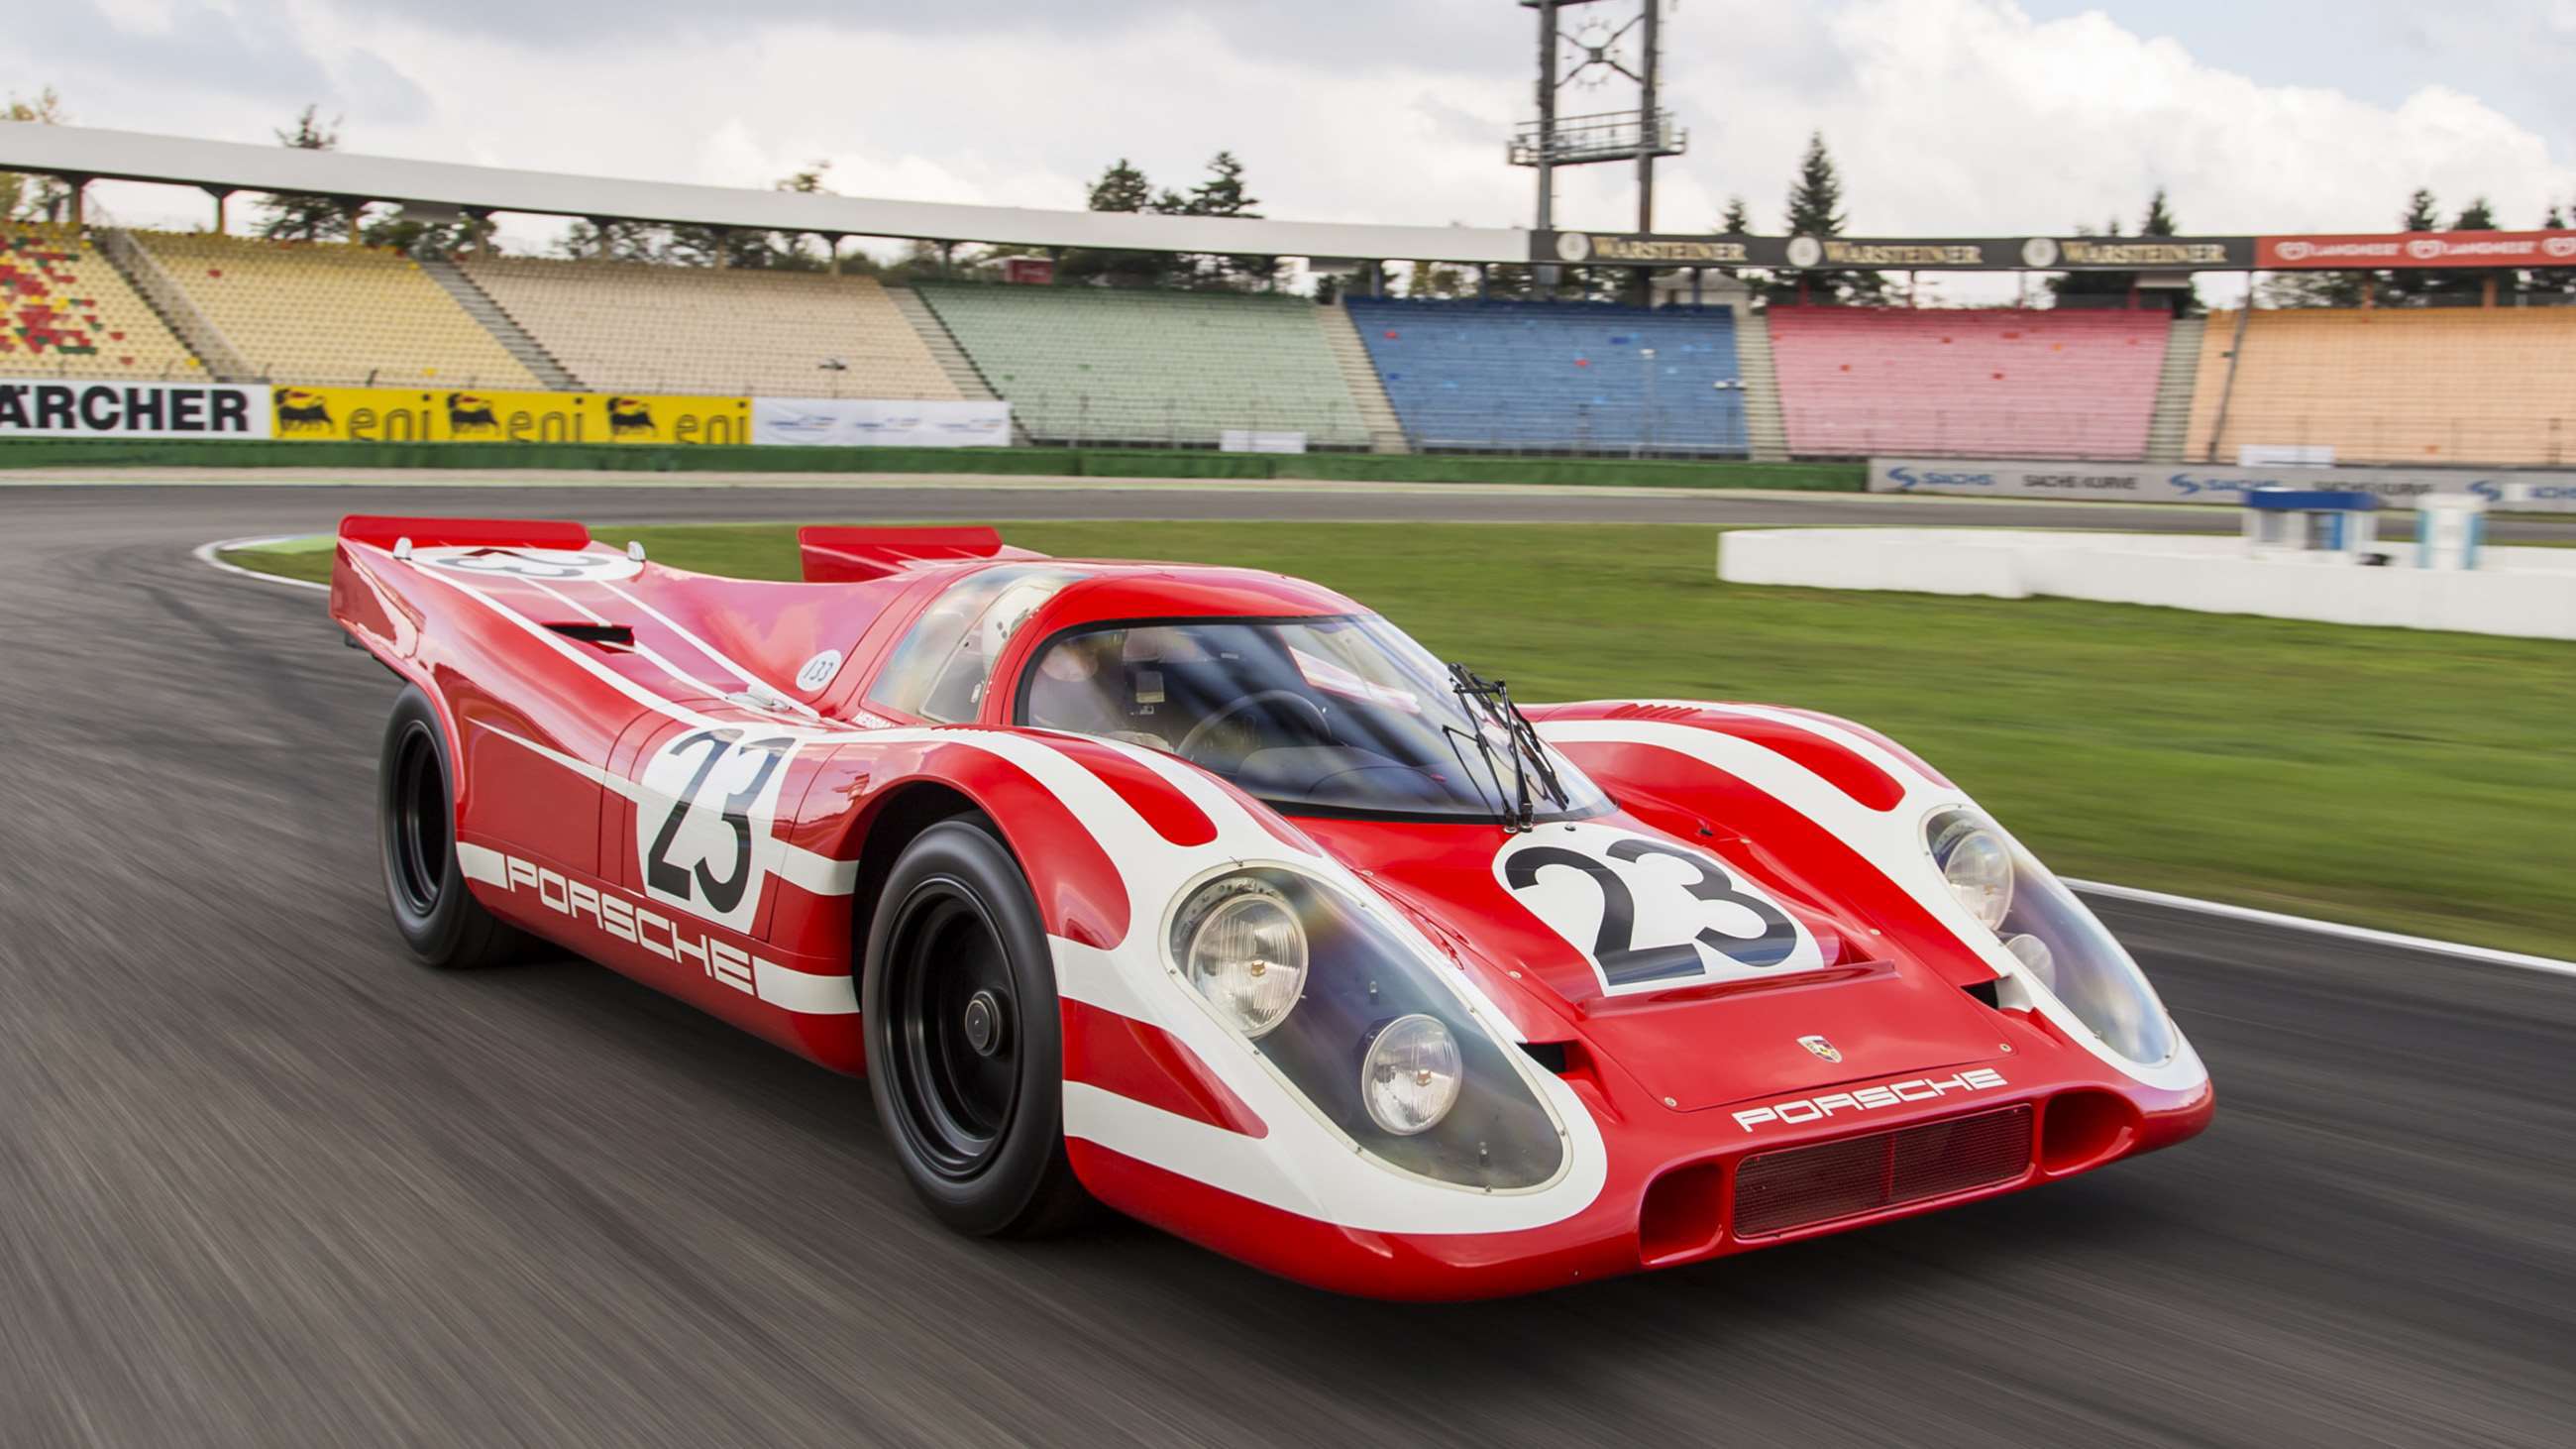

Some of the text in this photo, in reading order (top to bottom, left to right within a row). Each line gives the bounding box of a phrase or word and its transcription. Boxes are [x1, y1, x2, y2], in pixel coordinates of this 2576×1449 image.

[1591, 237, 1748, 261] WARSTEINER
[1823, 241, 1984, 264] WARSTEINER
[2061, 241, 2228, 264] WARSTEINER
[347, 393, 433, 442] eni
[506, 397, 586, 443] eni
[673, 400, 750, 445] eni
[1922, 471, 1996, 487] SACHS
[803, 659, 834, 682] 133
[647, 727, 797, 914] 23
[505, 855, 755, 996] PORSCHE
[1504, 838, 1797, 986] 23
[1731, 1067, 2008, 1133] PORSCHE
